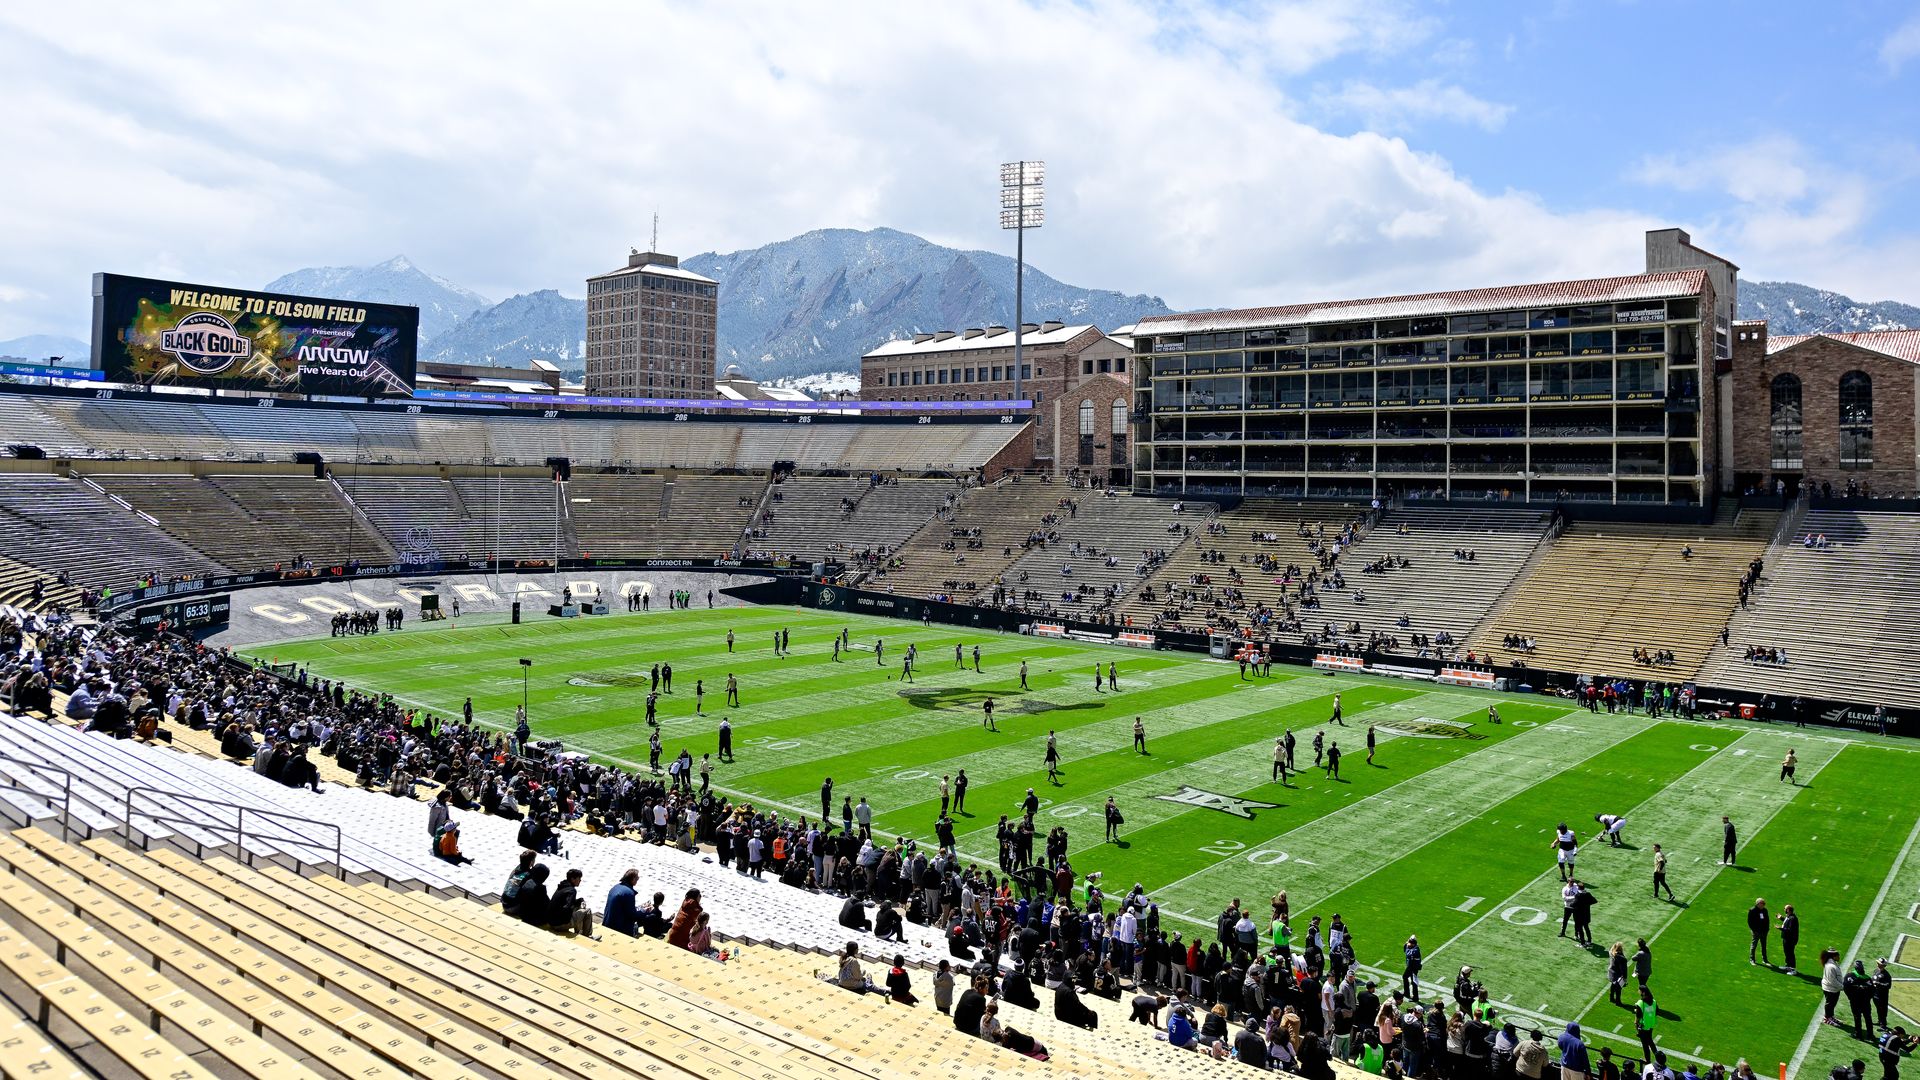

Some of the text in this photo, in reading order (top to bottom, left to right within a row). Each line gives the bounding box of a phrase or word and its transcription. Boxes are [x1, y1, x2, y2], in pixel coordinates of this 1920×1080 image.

[170, 289, 367, 324] WELCOME TO FOLSOM FIELD
[190, 317, 225, 327] COLORADO
[312, 328, 356, 339] Presented By
[164, 332, 205, 352] BLACK
[207, 333, 243, 354] GOLD
[298, 346, 369, 365] ARROW
[298, 366, 368, 378] Five Years Out
[96, 390, 112, 399] 210
[258, 398, 274, 408] 209
[406, 406, 422, 414] 208
[544, 410, 559, 418] 207
[674, 413, 688, 421] 206
[918, 416, 931, 424] 204
[398, 549, 440, 565] Allstate
[720, 559, 742, 567] Fowler
[330, 566, 342, 576] 40
[356, 566, 386, 575] Anthem
[144, 580, 204, 598] COLORADO BUFFALOES
[186, 604, 208, 618] 65:33
[1847, 710, 1898, 724] ELEVATINS
[1198, 840, 1289, 865] 20
[1444, 895, 1548, 926] 10
[1274, 971, 1280, 984] 1
[1094, 977, 1104, 990] 12
[84, 1006, 104, 1015] 19
[197, 1018, 215, 1027] 19
[110, 1025, 131, 1035] 20
[298, 1028, 315, 1036] 19
[1172, 1024, 1176, 1034] 3
[1, 1037, 23, 1048] 21
[225, 1036, 245, 1046] 20
[140, 1048, 161, 1058] 21
[328, 1046, 347, 1055] 20
[258, 1058, 278, 1067] 21
[418, 1056, 436, 1065] 20
[505, 1060, 522, 1068] 20
[27, 1060, 52, 1074] 22
[363, 1067, 381, 1076] 21
